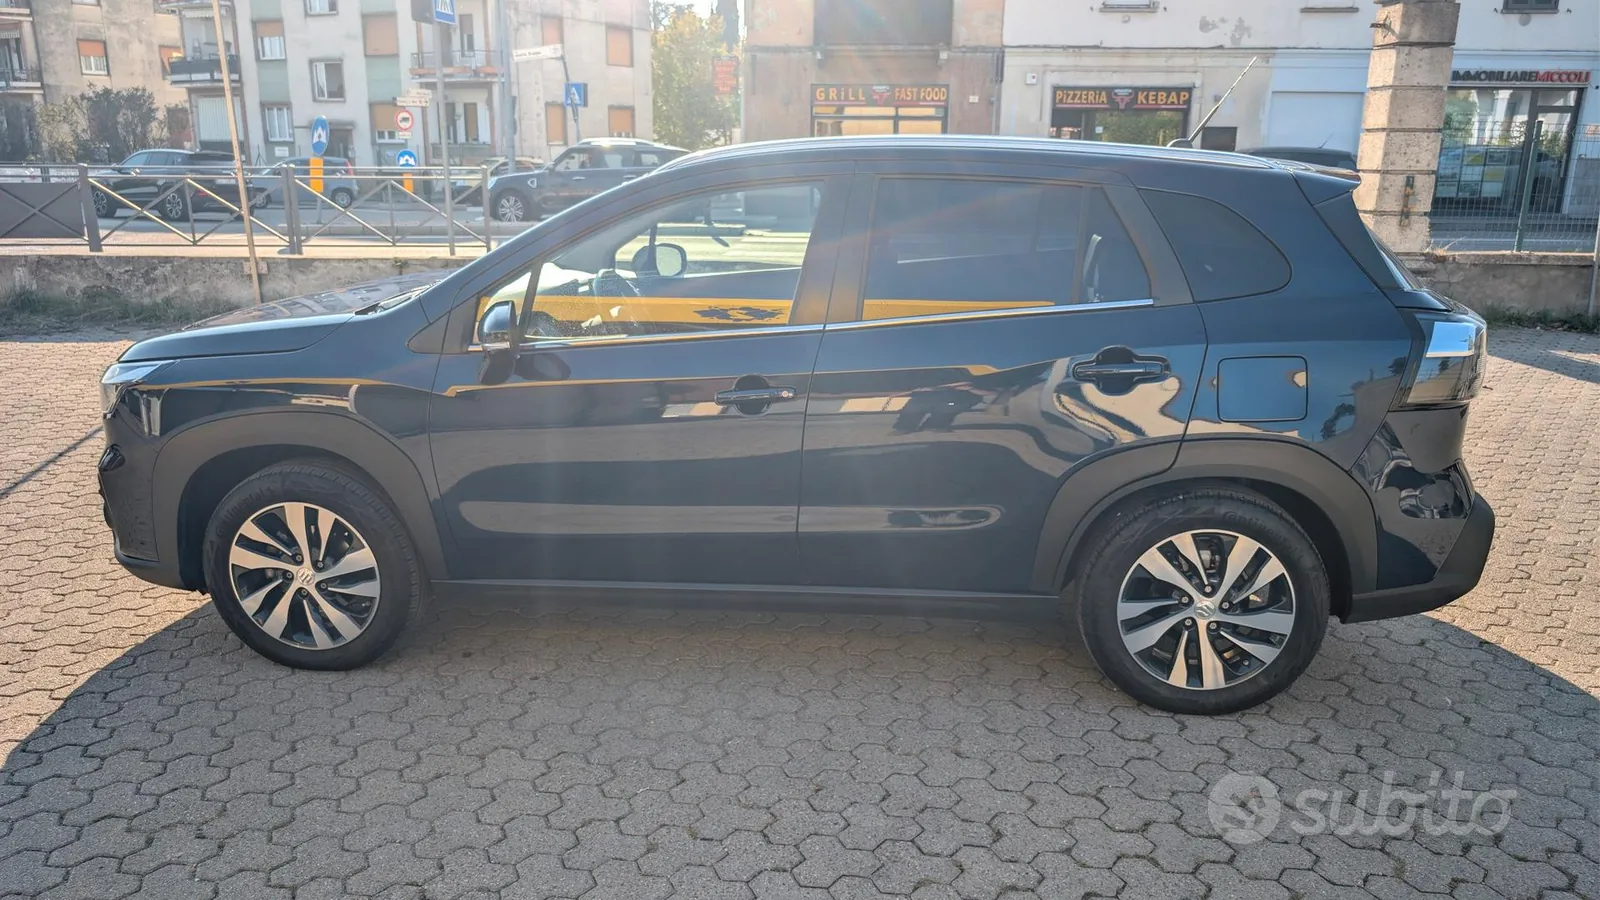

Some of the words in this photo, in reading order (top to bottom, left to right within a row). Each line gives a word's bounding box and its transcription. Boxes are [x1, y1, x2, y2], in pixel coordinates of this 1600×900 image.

[894, 87, 918, 100] FAST
[920, 87, 947, 100] FOOD
[1137, 91, 1190, 104] KEBAP
